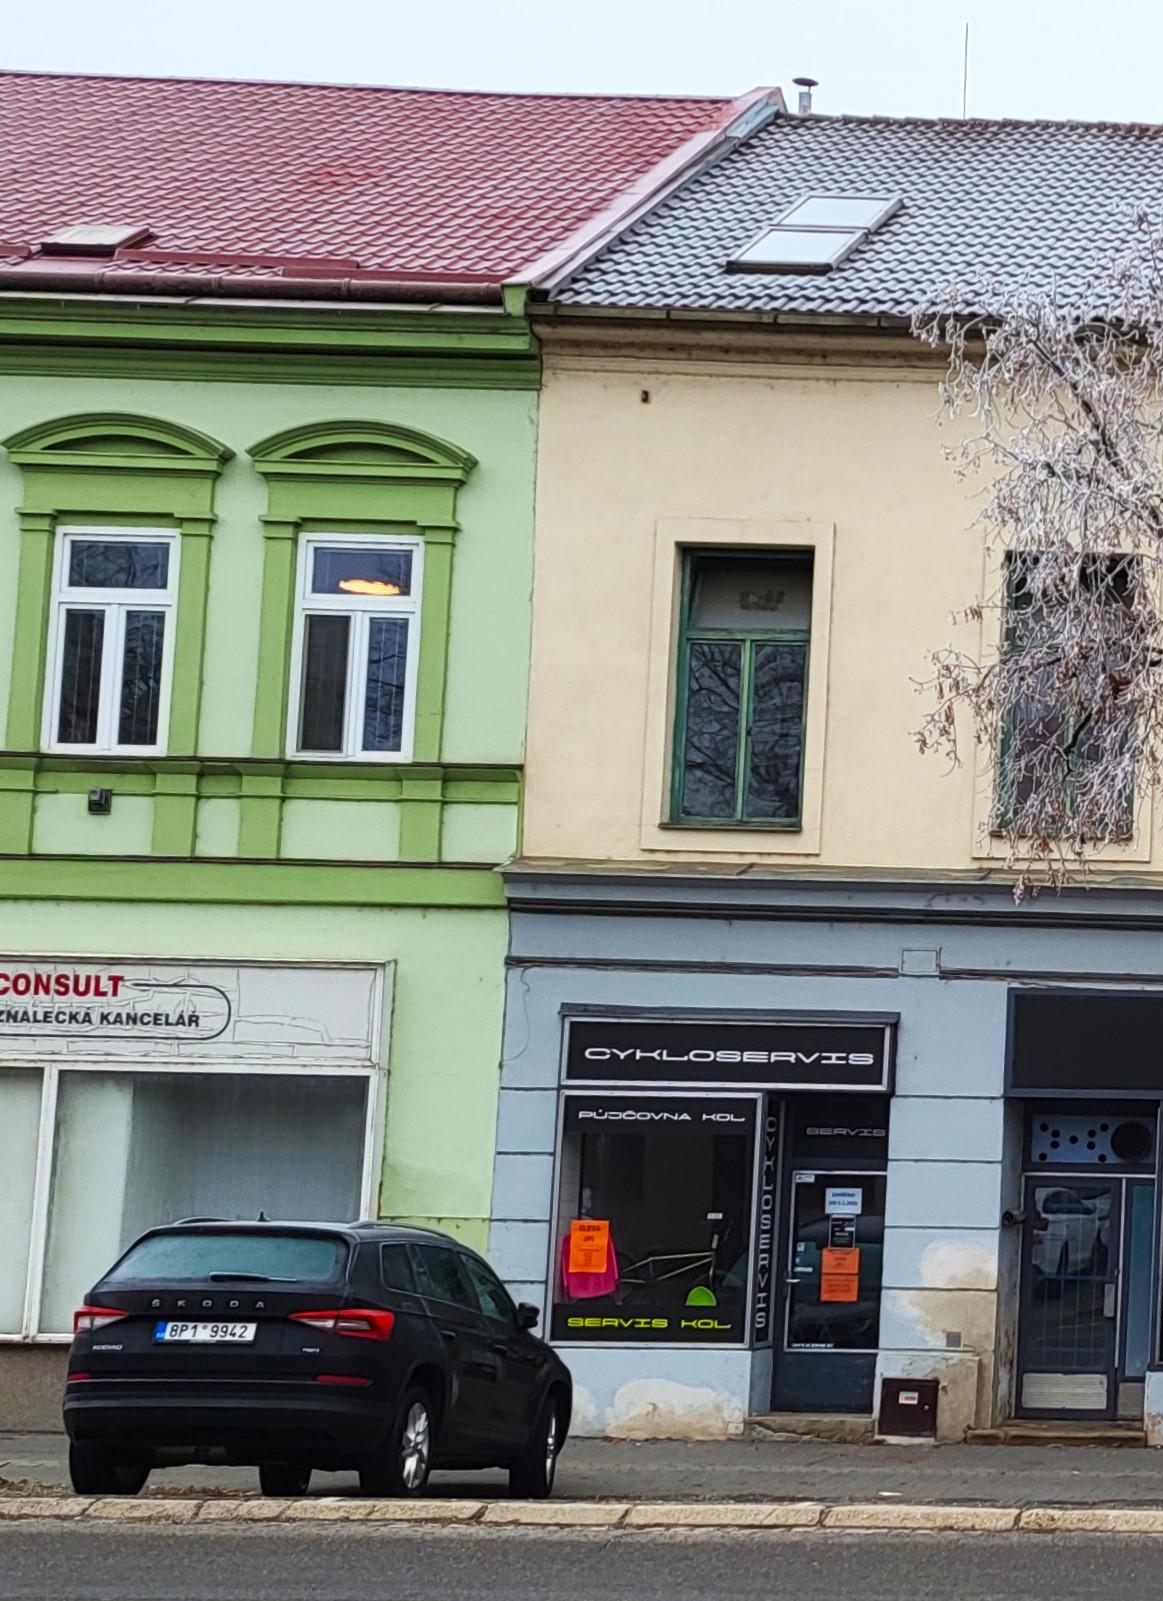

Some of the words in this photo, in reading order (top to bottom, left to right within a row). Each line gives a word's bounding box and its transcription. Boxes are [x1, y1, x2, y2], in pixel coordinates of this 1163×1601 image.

[99, 1009, 200, 1028] KANCELÁŘ
[584, 1047, 875, 1065] CYKLOSERVIS
[702, 1113, 746, 1122] KOL
[806, 1127, 886, 1137] SERVIS
[755, 1116, 777, 1329] CYKLOSERVIS
[567, 1317, 669, 1329] SERVIS
[681, 1319, 732, 1329] KOL
[168, 1324, 198, 1338] 8P1
[210, 1325, 249, 1339] 9942
